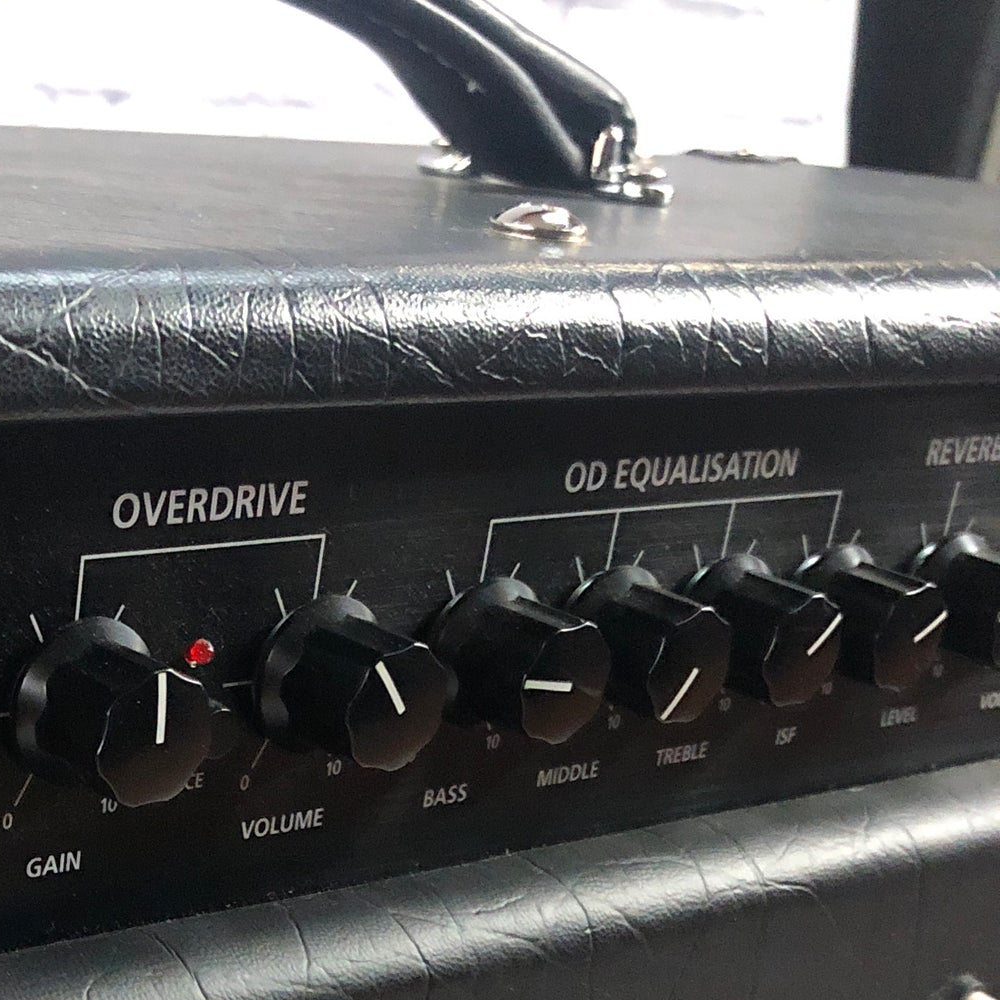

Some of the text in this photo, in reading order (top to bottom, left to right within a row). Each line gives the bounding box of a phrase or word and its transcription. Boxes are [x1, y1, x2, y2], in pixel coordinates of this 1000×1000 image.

[564, 448, 800, 493] OD EQUALISATION
[112, 480, 309, 531] OVERDRIVE
[326, 759, 342, 776] 10
[656, 741, 709, 767] TREBLE
[239, 774, 251, 791] 0
[536, 760, 600, 788] MIDDLE
[422, 783, 468, 809] BASS
[2, 812, 14, 830] 0
[241, 807, 325, 840] VOLUME
[26, 850, 82, 878] GAIN
